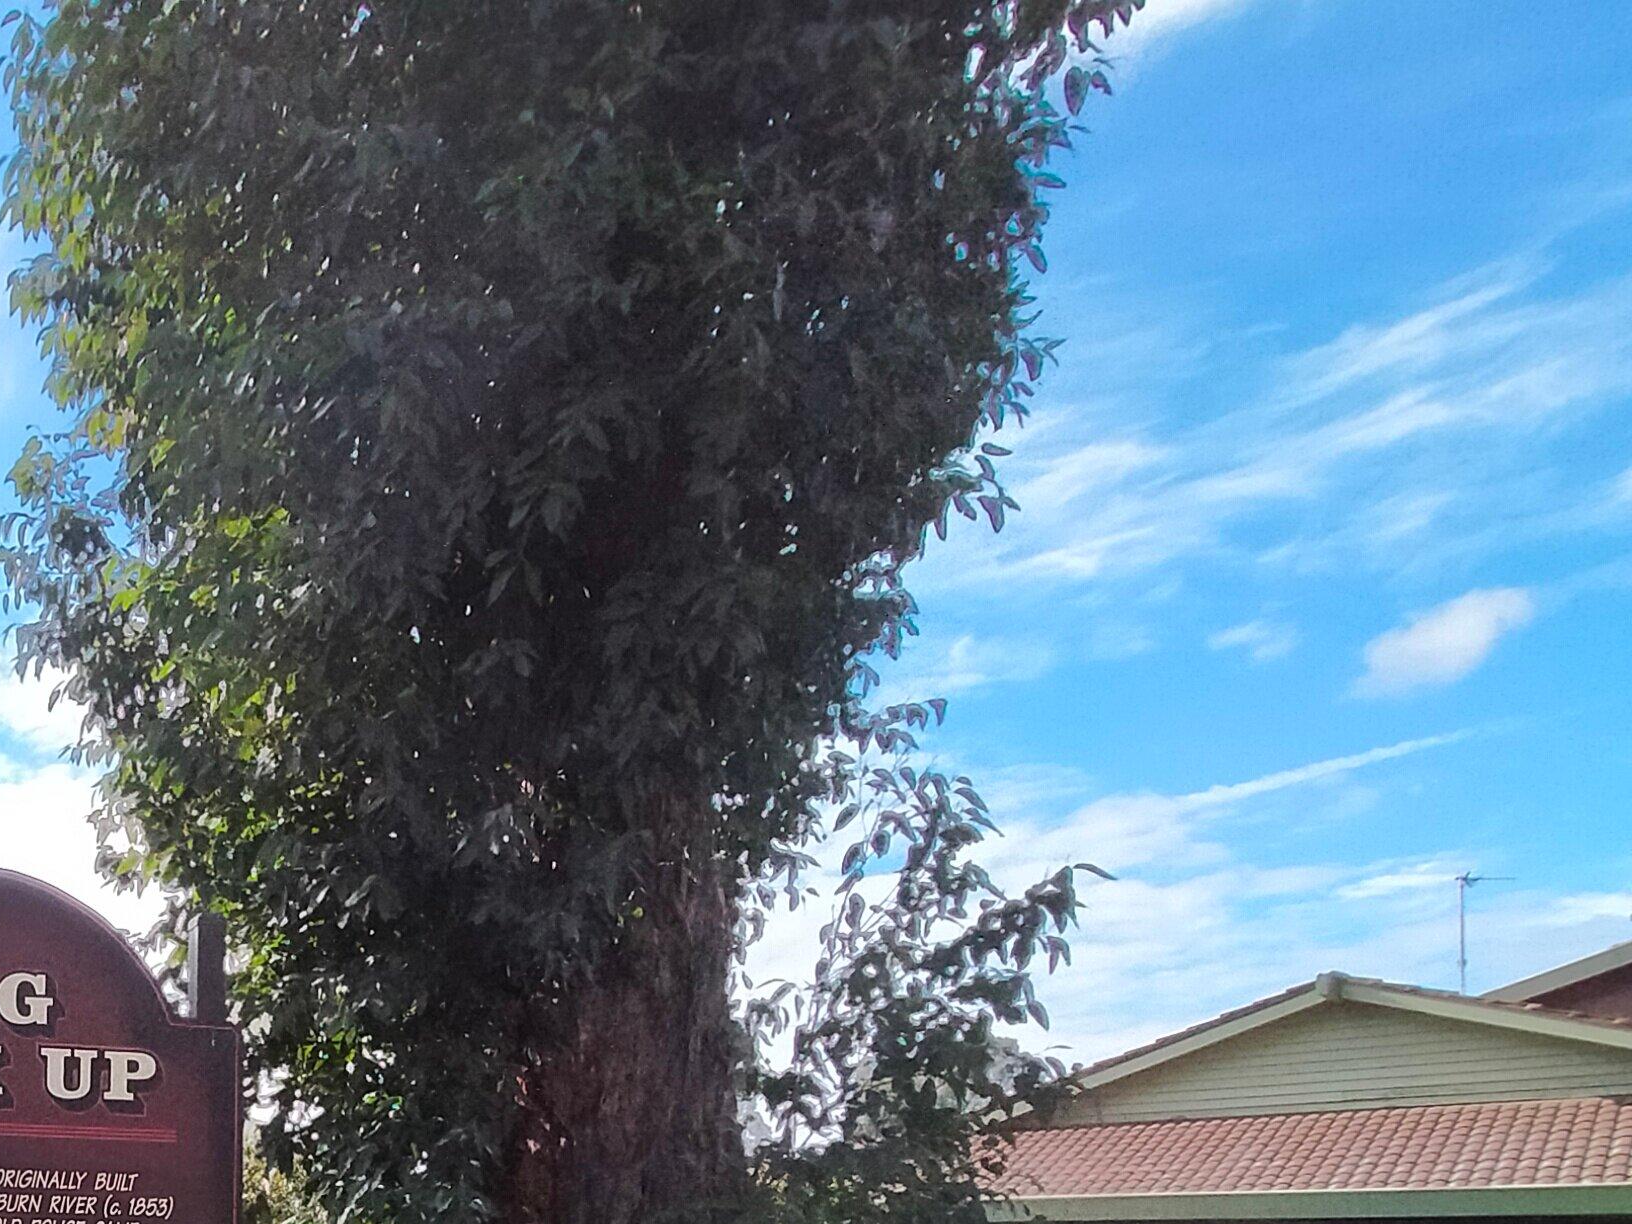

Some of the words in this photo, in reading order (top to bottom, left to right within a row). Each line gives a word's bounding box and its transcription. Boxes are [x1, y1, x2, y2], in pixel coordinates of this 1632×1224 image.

[39, 1045, 158, 1102] UP
[94, 1172, 139, 1192] BUILT
[48, 1195, 98, 1215] RIVER
[103, 1193, 122, 1219] (c.
[128, 1195, 174, 1220] 1853)
